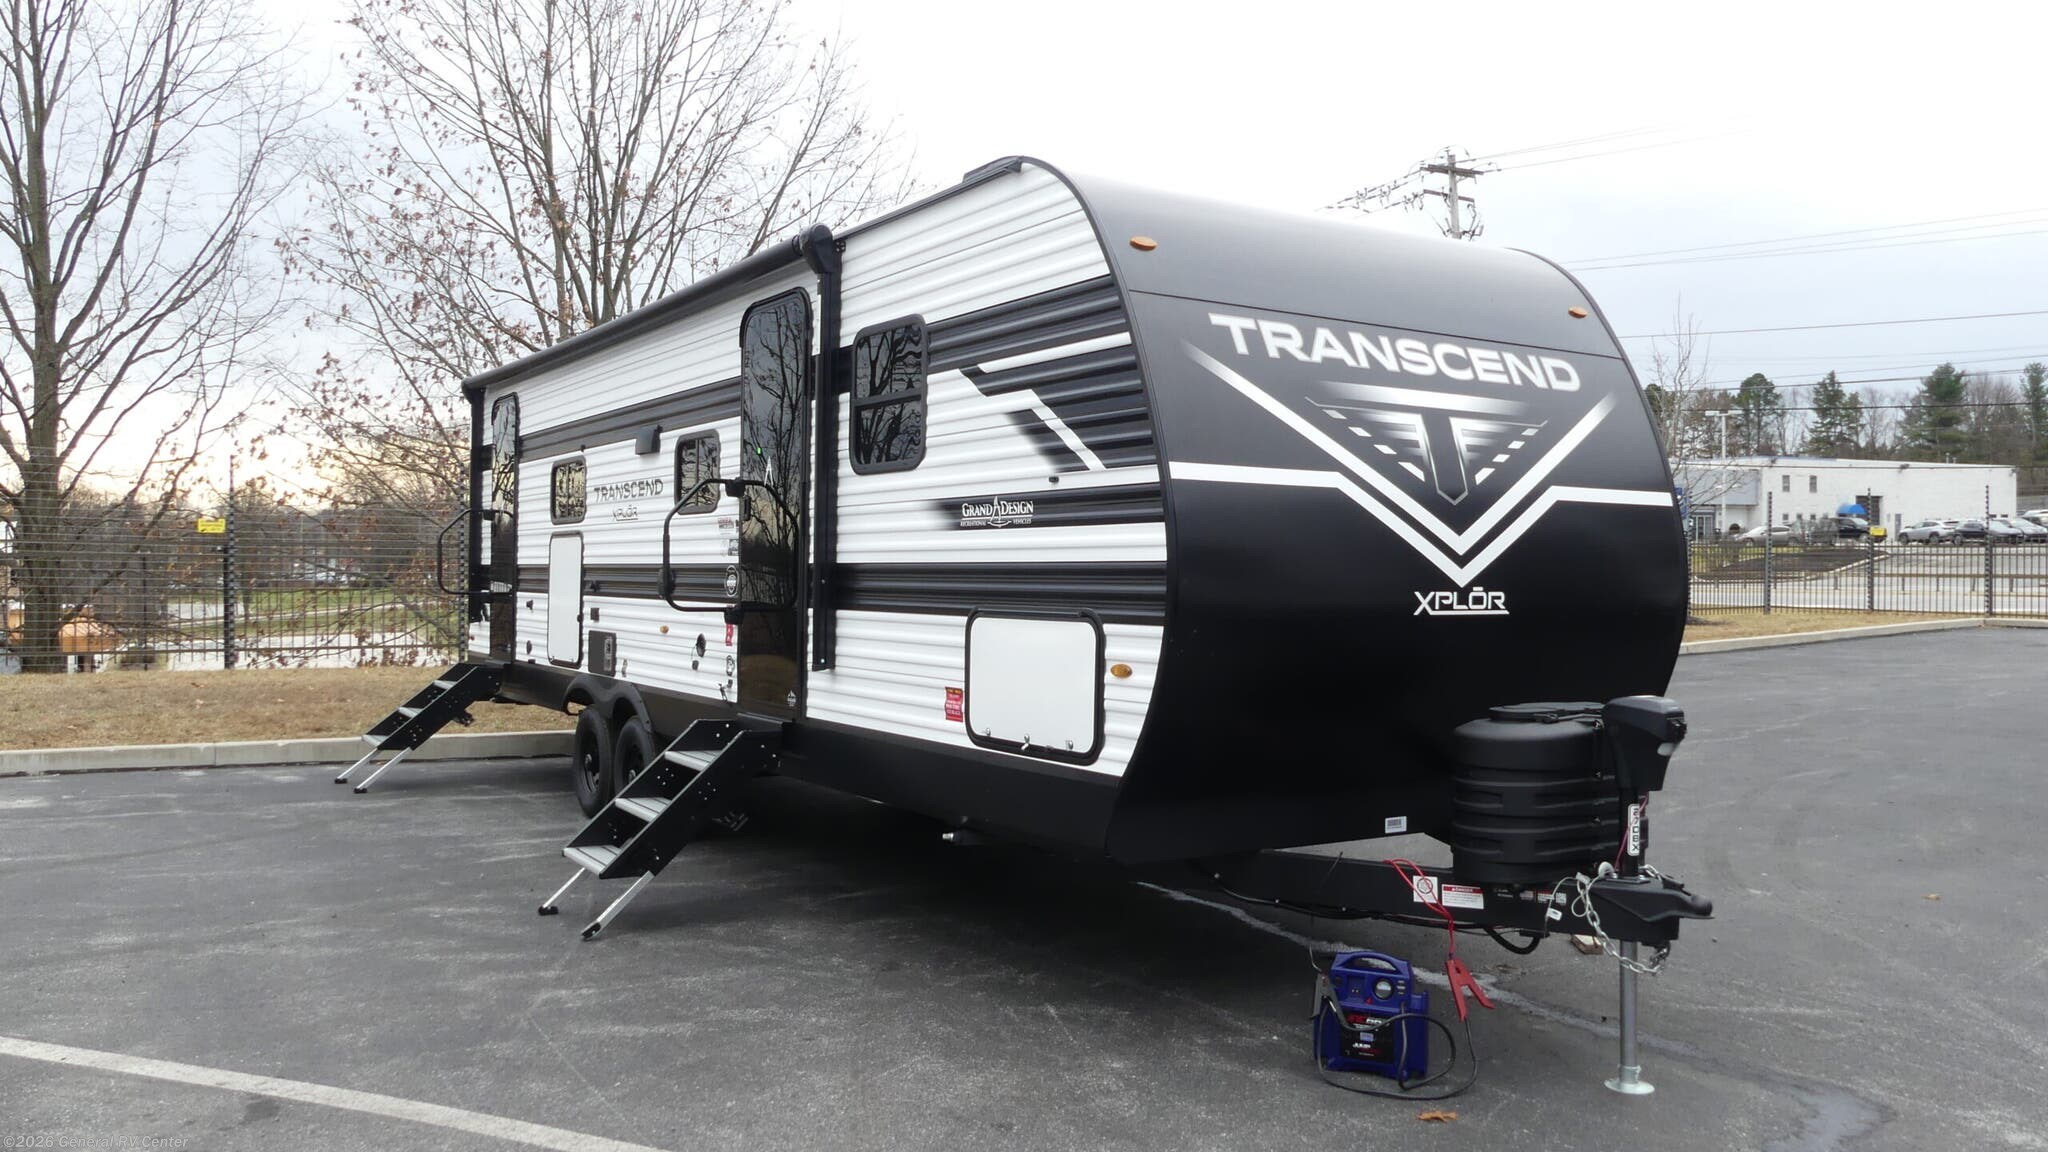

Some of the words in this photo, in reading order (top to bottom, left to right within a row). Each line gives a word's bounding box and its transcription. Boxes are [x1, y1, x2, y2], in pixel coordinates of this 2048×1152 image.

[1208, 313, 1582, 392] TRANSCEND
[594, 479, 664, 502] TRANSCEND
[961, 502, 993, 517] GRAND
[1000, 500, 1034, 515] DESIGN
